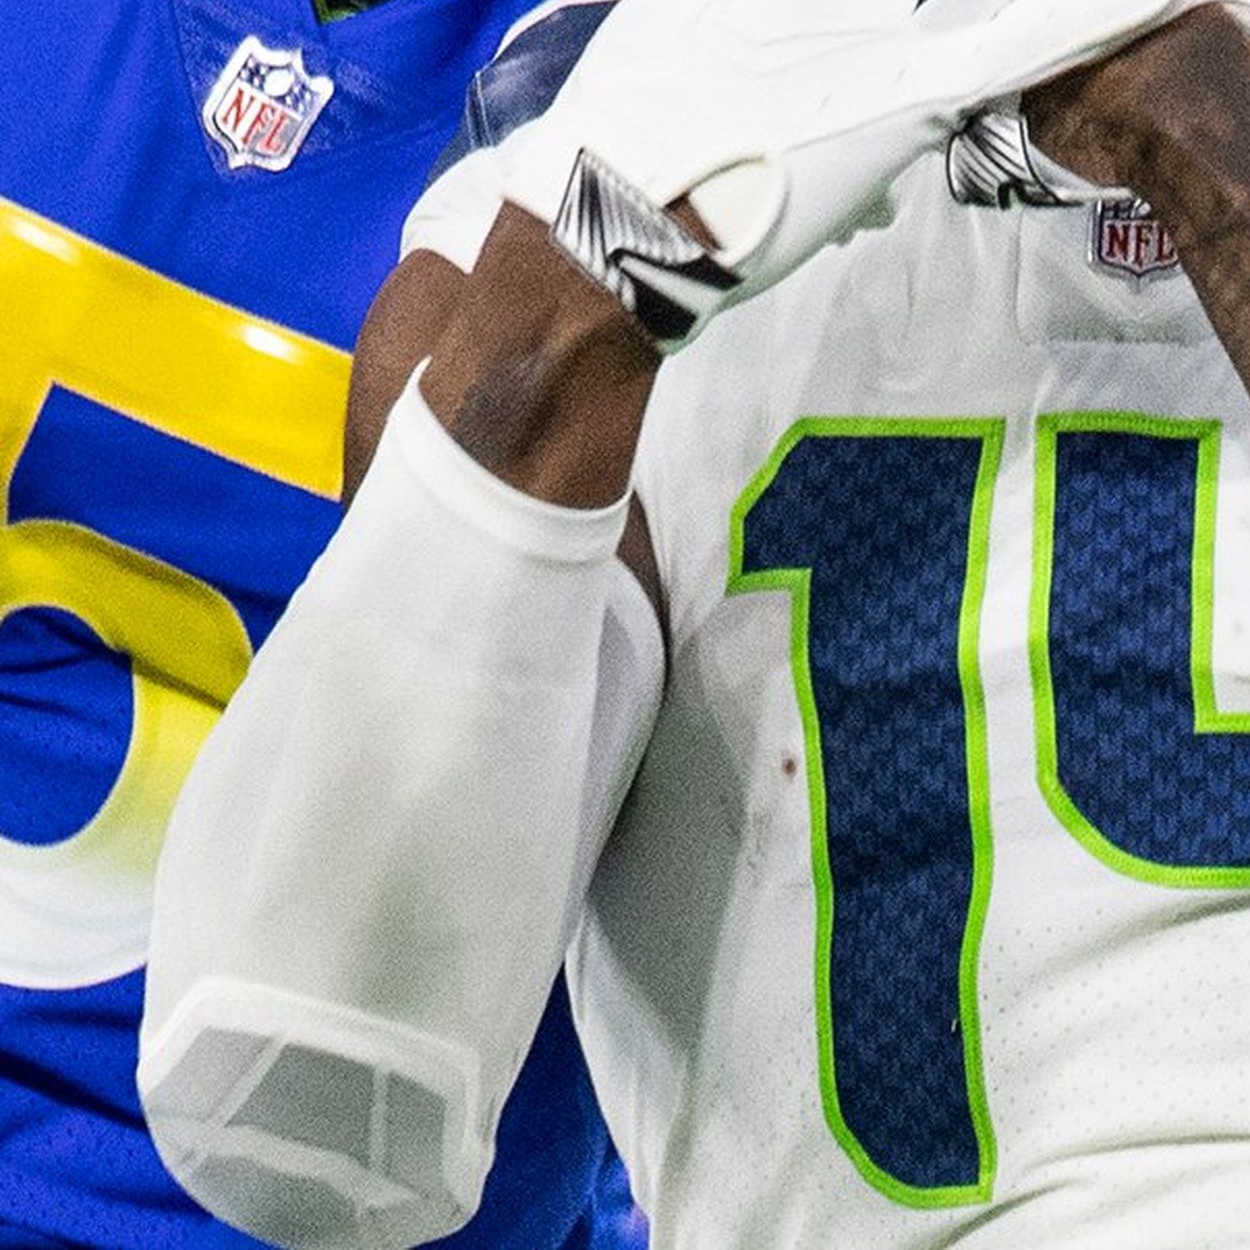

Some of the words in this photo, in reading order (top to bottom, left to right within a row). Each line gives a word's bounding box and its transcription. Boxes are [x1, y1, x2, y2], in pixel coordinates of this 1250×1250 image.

[222, 87, 287, 151] NFL
[1105, 223, 1175, 268] NFL
[0, 196, 354, 989] 5
